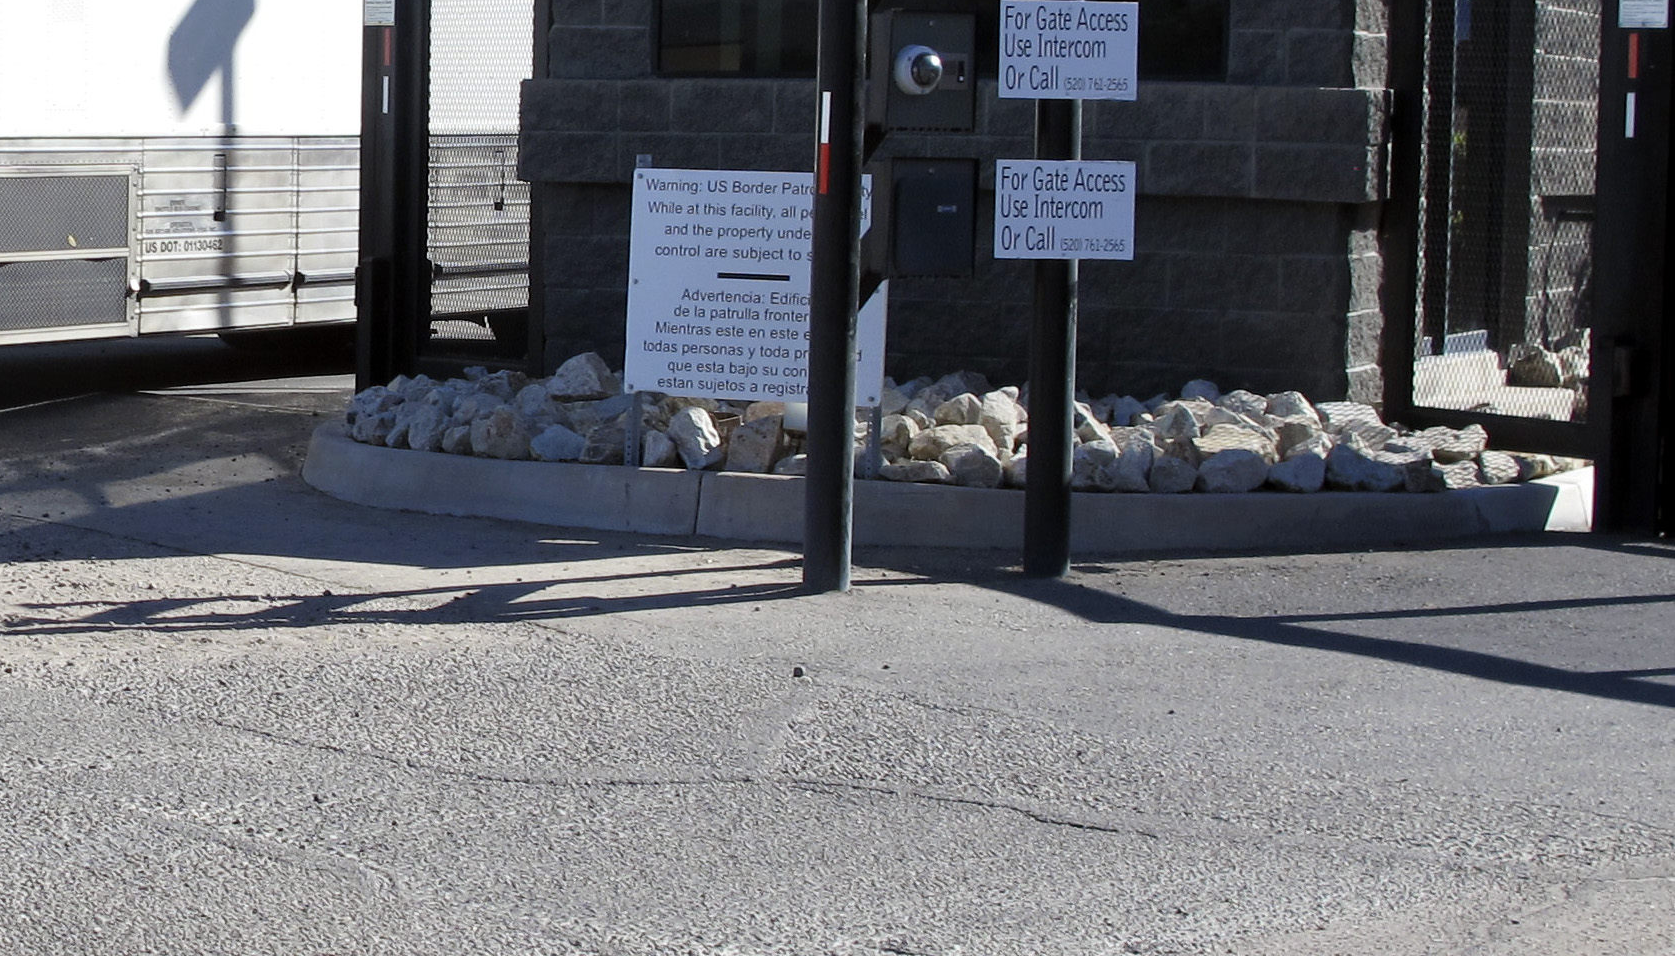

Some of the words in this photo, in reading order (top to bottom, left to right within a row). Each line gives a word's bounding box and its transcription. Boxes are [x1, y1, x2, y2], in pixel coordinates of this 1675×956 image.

[1005, 6, 1031, 30] For
[1037, 6, 1071, 30] Gate
[1077, 7, 1128, 32] Access
[1005, 33, 1031, 58] Use
[1037, 34, 1106, 58] Intercom
[1006, 65, 1024, 90] Or
[1030, 65, 1058, 90] Call
[1064, 77, 1085, 90] (520)
[1088, 78, 1128, 91] 761-2565
[646, 178, 702, 195] Warning:
[708, 181, 727, 193] US
[733, 181, 777, 194] Border
[1001, 166, 1028, 190] For
[1033, 166, 1068, 191] Gate
[1073, 168, 1125, 192] Access
[648, 201, 682, 214] While
[687, 204, 699, 214] at
[704, 203, 725, 216] this
[731, 203, 775, 220] facility,
[781, 206, 796, 218] all
[1001, 194, 1028, 218] Use
[1034, 194, 1103, 218] Intercom
[665, 224, 688, 236] and
[693, 225, 712, 236] the
[718, 227, 772, 241] property
[778, 227, 811, 240] unde
[1001, 226, 1021, 250] Or
[1026, 226, 1055, 250] Call
[1060, 238, 1083, 251] (520)
[1085, 239, 1125, 252] 761-2565
[145, 242, 157, 253] US
[161, 241, 181, 252] DOT:
[655, 244, 700, 256] control
[705, 247, 727, 258] are
[733, 247, 783, 262] subject
[788, 250, 801, 261] to
[682, 289, 765, 304] Advertencia:
[771, 292, 810, 305] Edifici
[674, 305, 690, 317] de
[694, 306, 705, 318] la
[710, 307, 759, 321] patrulla
[764, 309, 810, 323] fronter
[656, 322, 711, 335] Mientras
[716, 326, 744, 338] este
[749, 329, 765, 339] en
[770, 328, 799, 340] este
[643, 340, 677, 353] todas
[682, 345, 744, 357] personas
[748, 348, 755, 358] y
[760, 345, 789, 358] toda
[668, 361, 692, 375] que
[697, 362, 724, 374] esta
[729, 362, 757, 377] bajo
[762, 366, 778, 376] su
[657, 378, 693, 390] estan
[698, 379, 745, 394] sujetos
[749, 383, 757, 392] a
